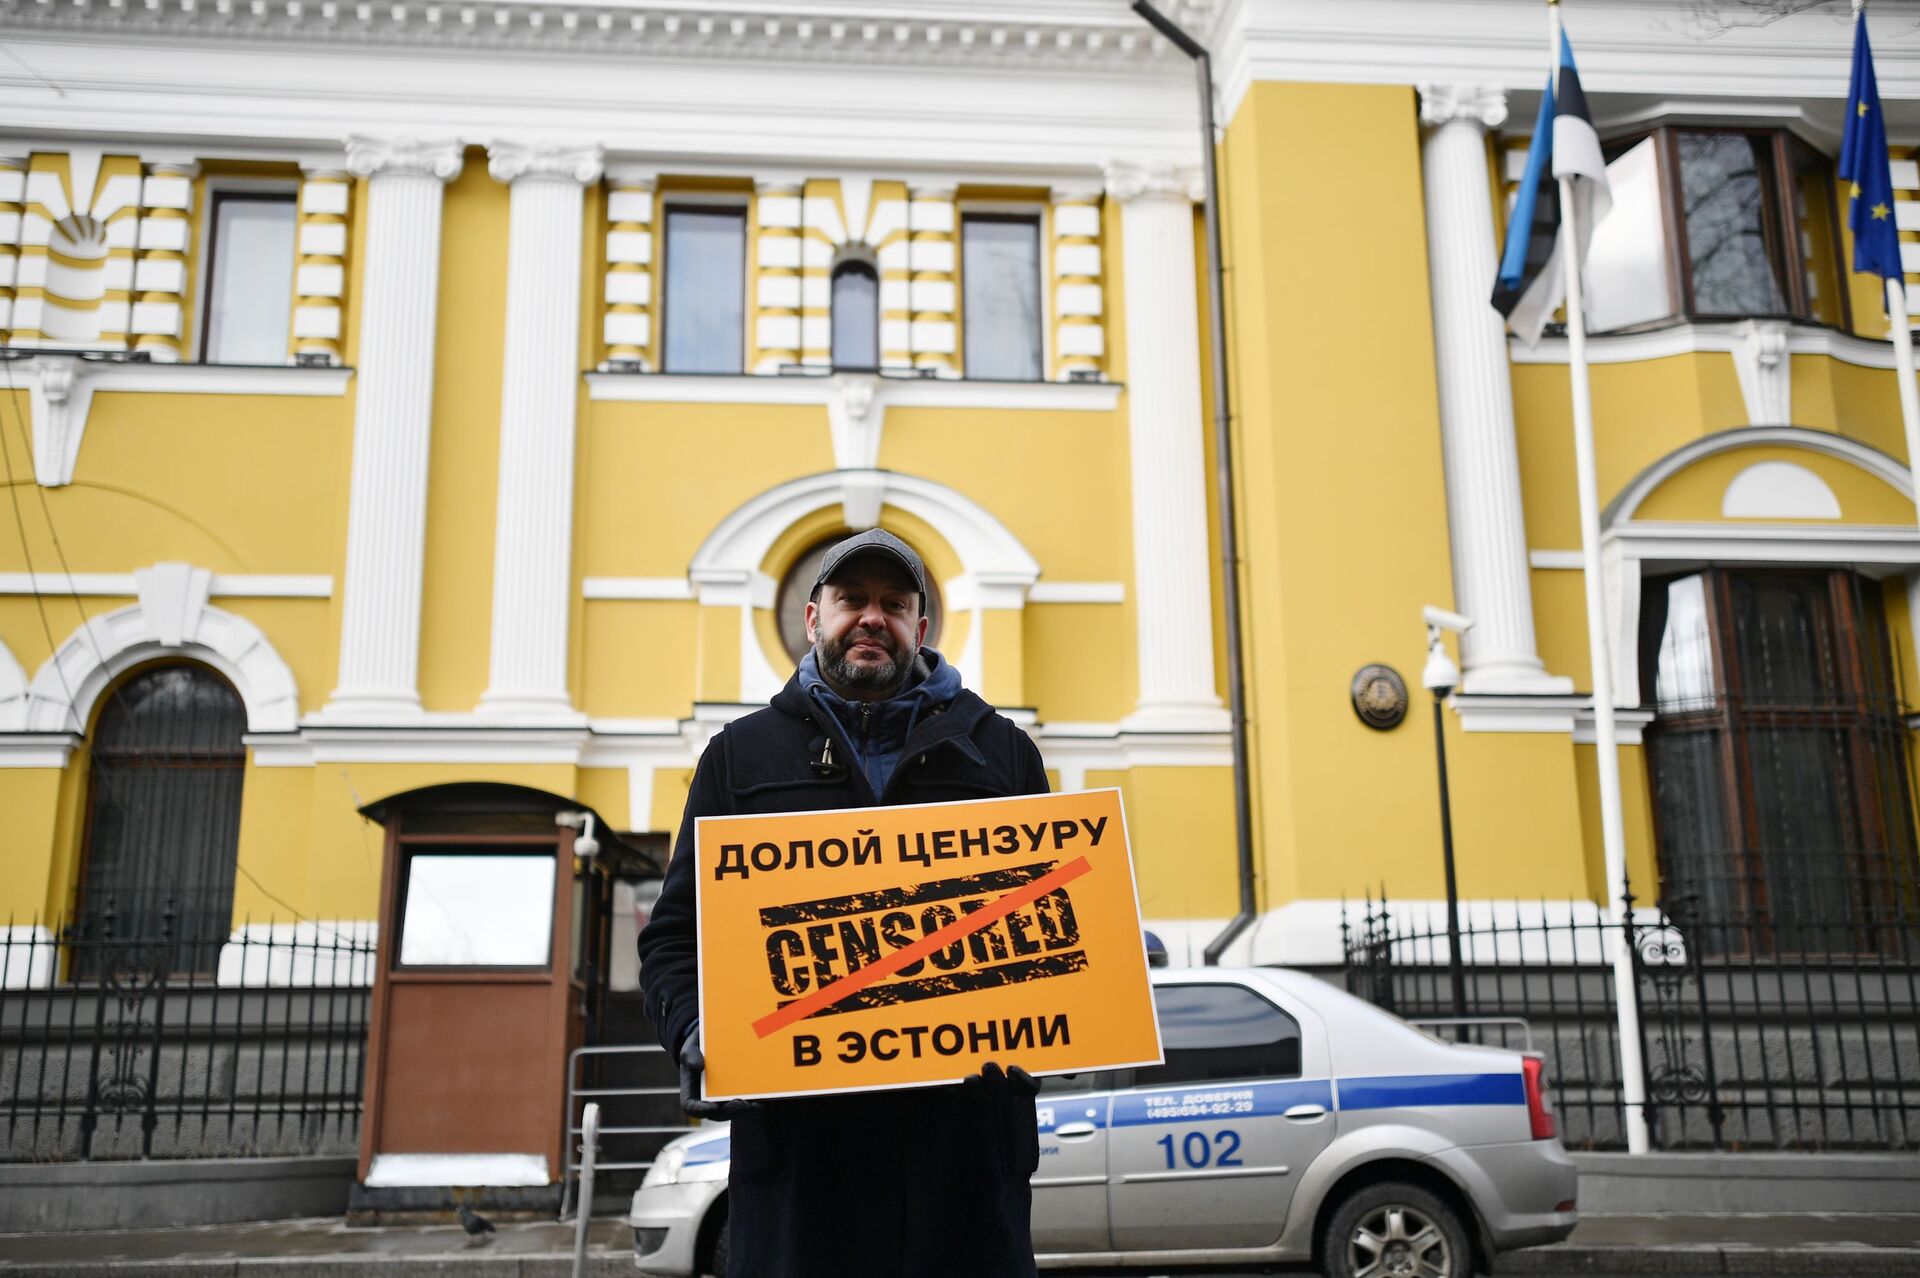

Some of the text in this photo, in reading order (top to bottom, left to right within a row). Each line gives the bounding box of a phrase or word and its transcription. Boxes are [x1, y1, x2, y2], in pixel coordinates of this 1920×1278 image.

[715, 816, 1108, 880] ДОЛОЙ ЦЕНЗУРУ
[765, 887, 1080, 996] CENSORED
[793, 1015, 1070, 1066] В ЭСТОНИИ
[1157, 1130, 1243, 1168] 102
